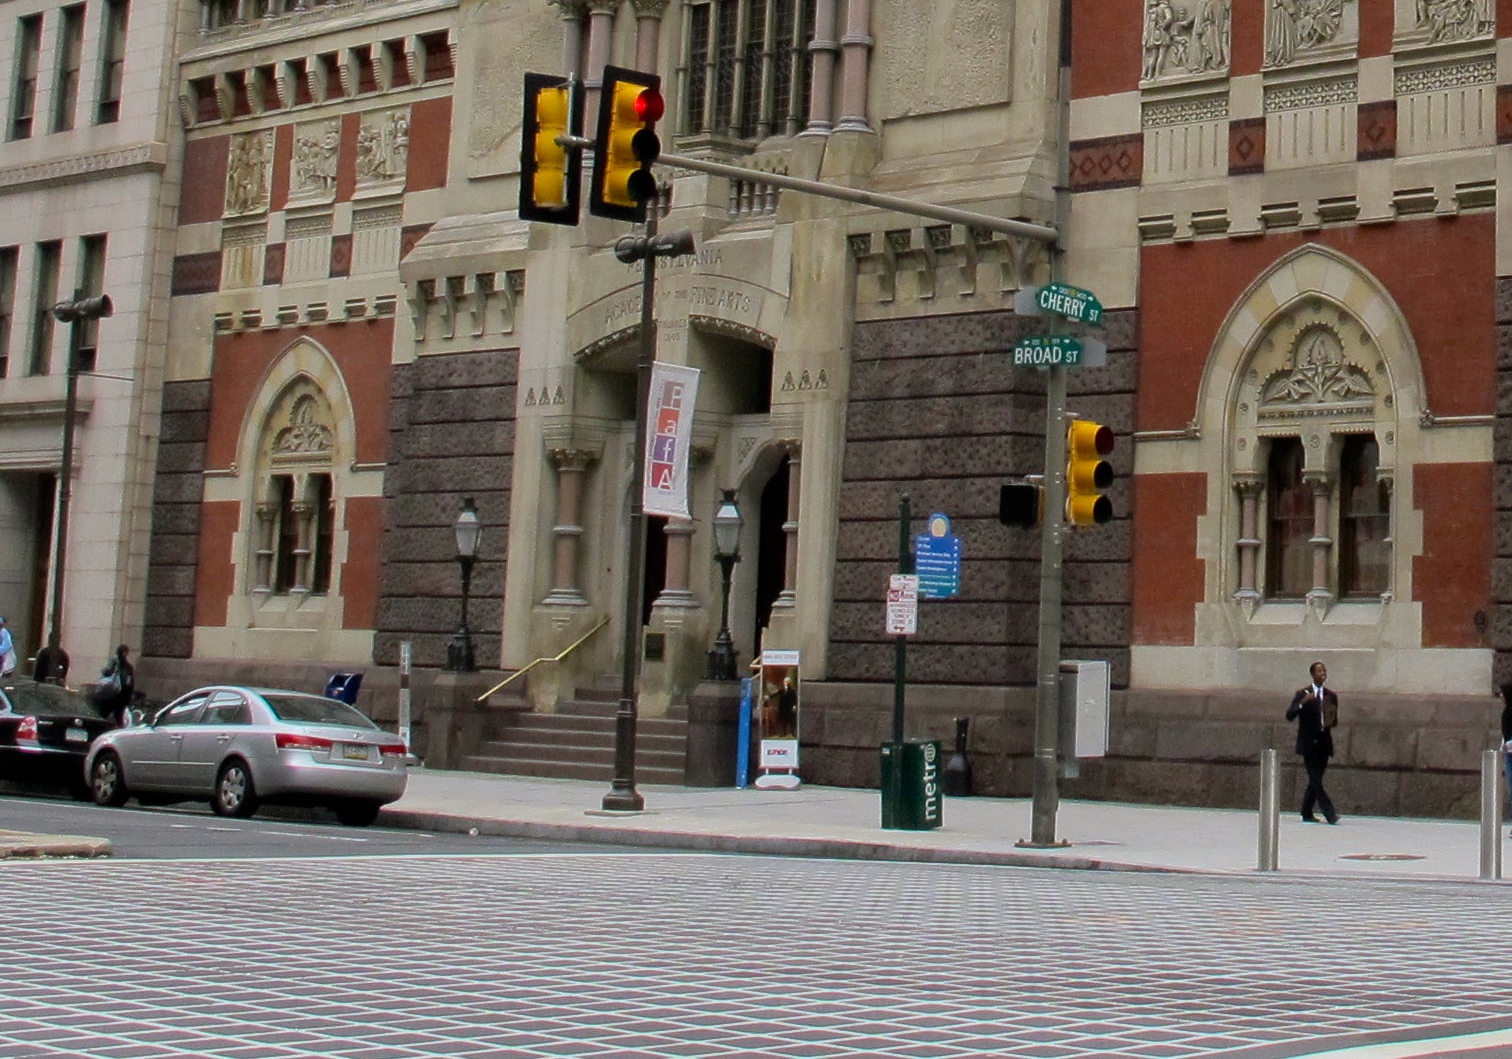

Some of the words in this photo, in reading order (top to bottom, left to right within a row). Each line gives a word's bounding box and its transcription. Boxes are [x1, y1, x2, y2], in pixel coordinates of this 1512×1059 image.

[718, 289, 751, 313] ARTS
[1040, 290, 1086, 318] CHERRY
[1089, 309, 1099, 322] ST
[1014, 346, 1062, 365] BROAD
[1065, 350, 1078, 363] ST
